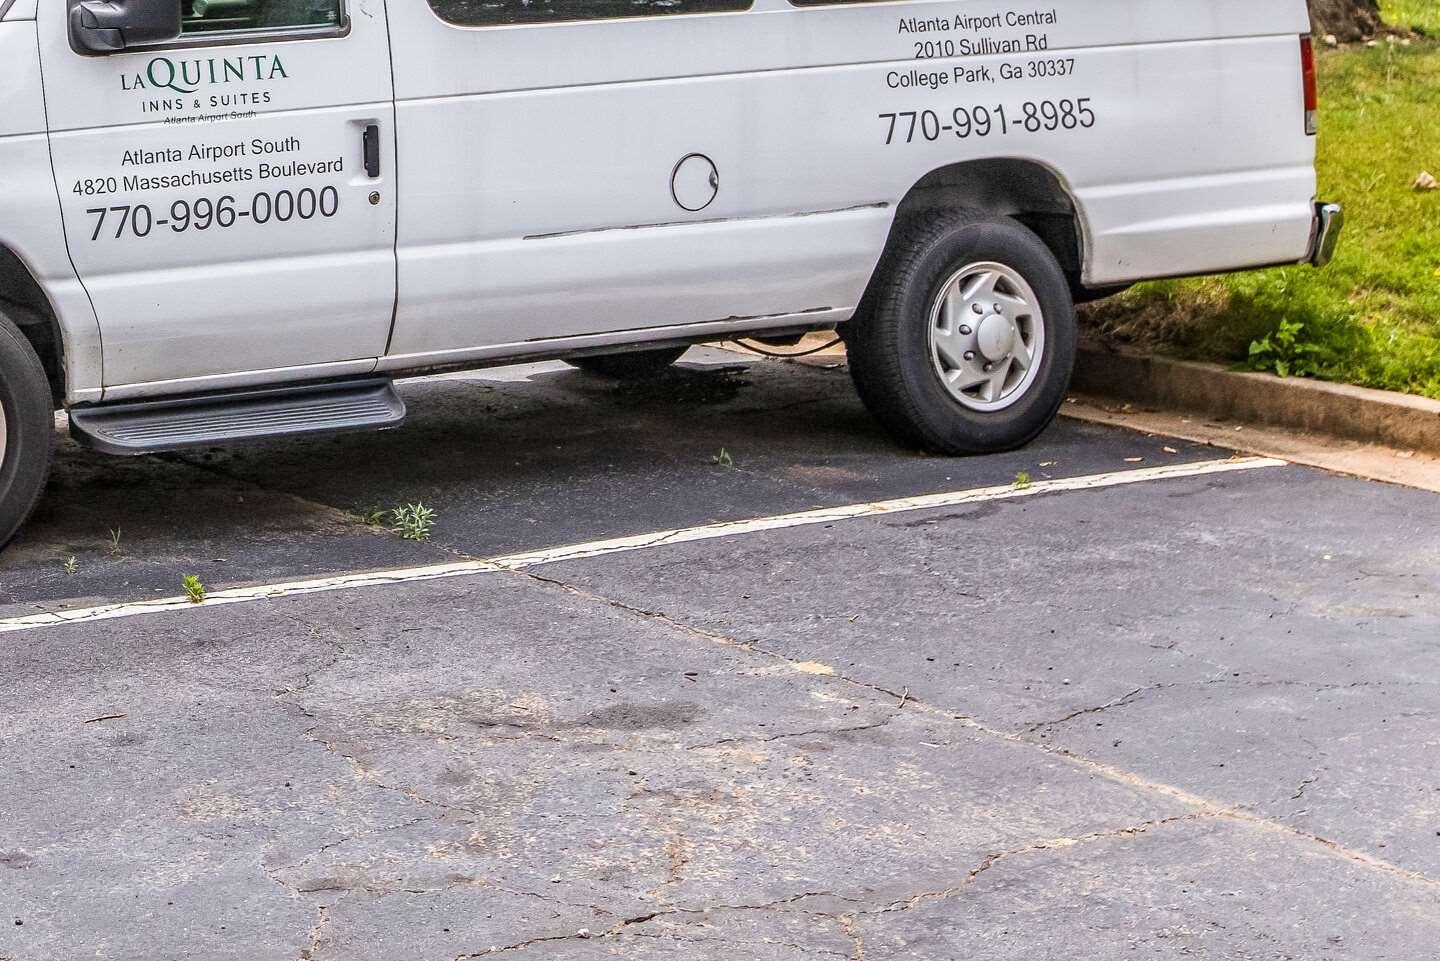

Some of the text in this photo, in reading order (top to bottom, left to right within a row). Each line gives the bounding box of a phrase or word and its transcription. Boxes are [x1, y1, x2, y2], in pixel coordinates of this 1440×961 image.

[898, 8, 1057, 34] Atlanta Airport Central
[914, 33, 1048, 60] 2010 Sullivan Rd
[886, 58, 1075, 90] College Park, Ga 30337
[142, 91, 271, 112] INNS & SUITES
[163, 110, 257, 124] Atlanta Airport South
[878, 97, 1096, 145] 770-991-8985
[121, 136, 301, 166] Atlanta Airport South
[72, 157, 344, 196] 4820 Massachusetts Boulevard
[86, 185, 340, 241] 770-996-0000
